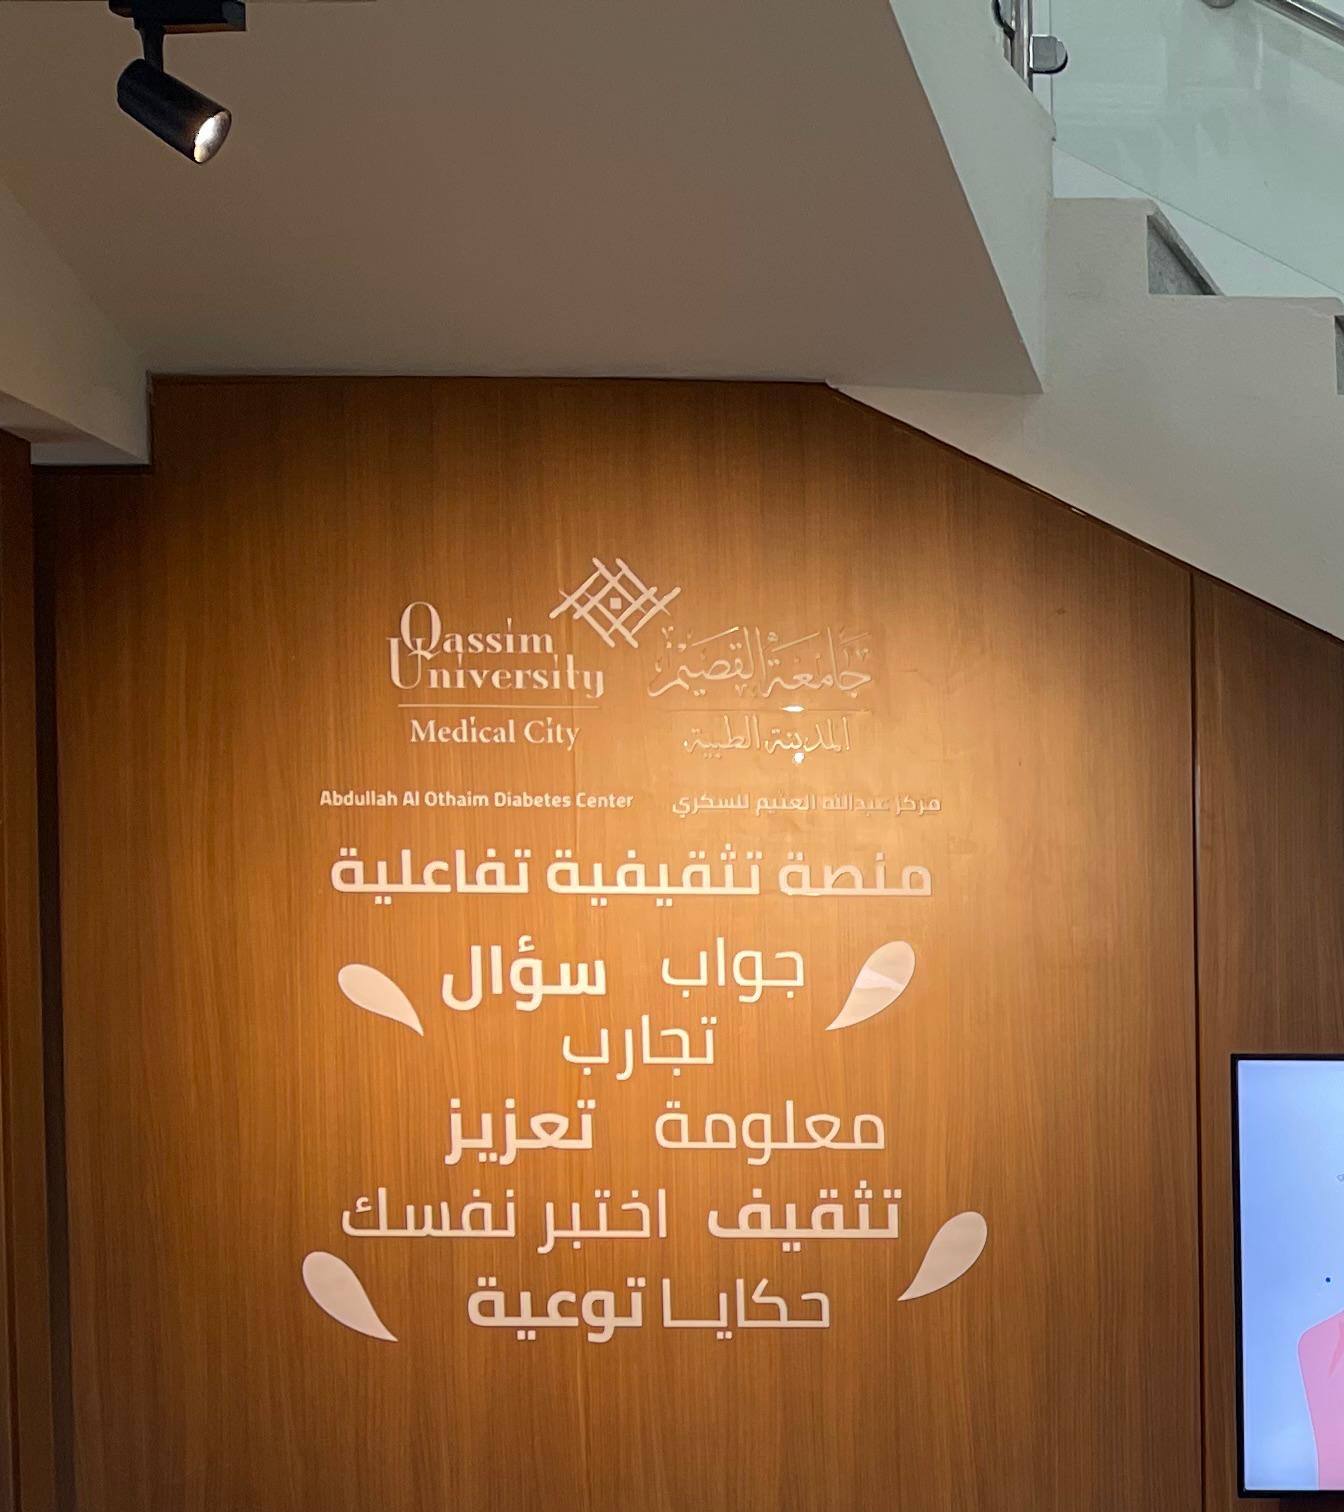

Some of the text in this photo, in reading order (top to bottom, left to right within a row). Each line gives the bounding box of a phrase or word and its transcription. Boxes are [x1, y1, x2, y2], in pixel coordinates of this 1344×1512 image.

[387, 633, 604, 698] University
[399, 603, 553, 666] Qassim
[411, 717, 579, 751] Medical City
[320, 791, 633, 808] Abdullah Al Othaim Diabetes Center
[673, 794, 748, 818] للسكري
[896, 795, 942, 816] مركز
[329, 844, 932, 907] منصة تثقيفية تفاعلية
[442, 935, 803, 1011] جواب سؤال
[563, 1015, 717, 1080] تجارب
[445, 1098, 884, 1165] معلومة تعزيز
[343, 1180, 902, 1253] تثقيف اختبر نفسك
[468, 1277, 829, 1342] حكايا توعية
